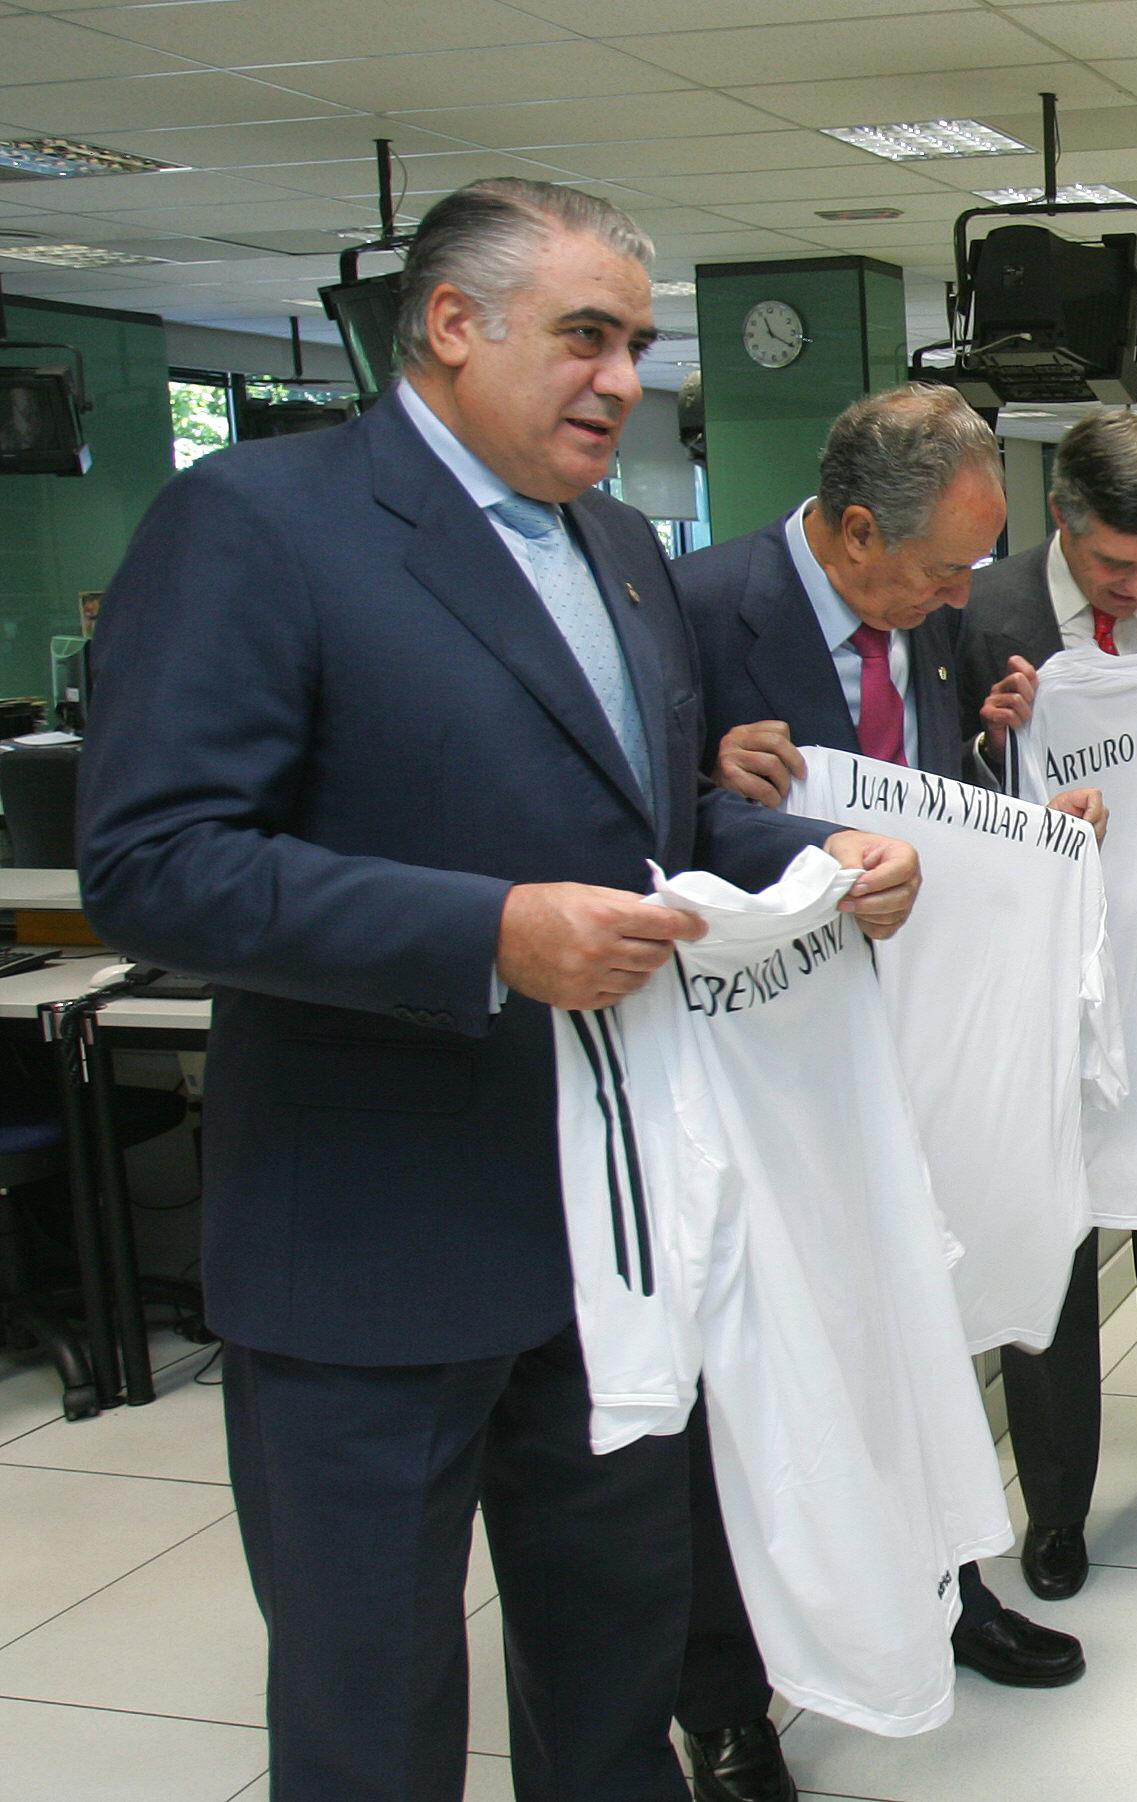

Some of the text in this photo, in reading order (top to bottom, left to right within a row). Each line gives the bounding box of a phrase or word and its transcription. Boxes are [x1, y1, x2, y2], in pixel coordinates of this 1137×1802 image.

[1045, 733, 1135, 786] ARTURO
[846, 758, 909, 814] JUAN
[918, 773, 953, 824] M.
